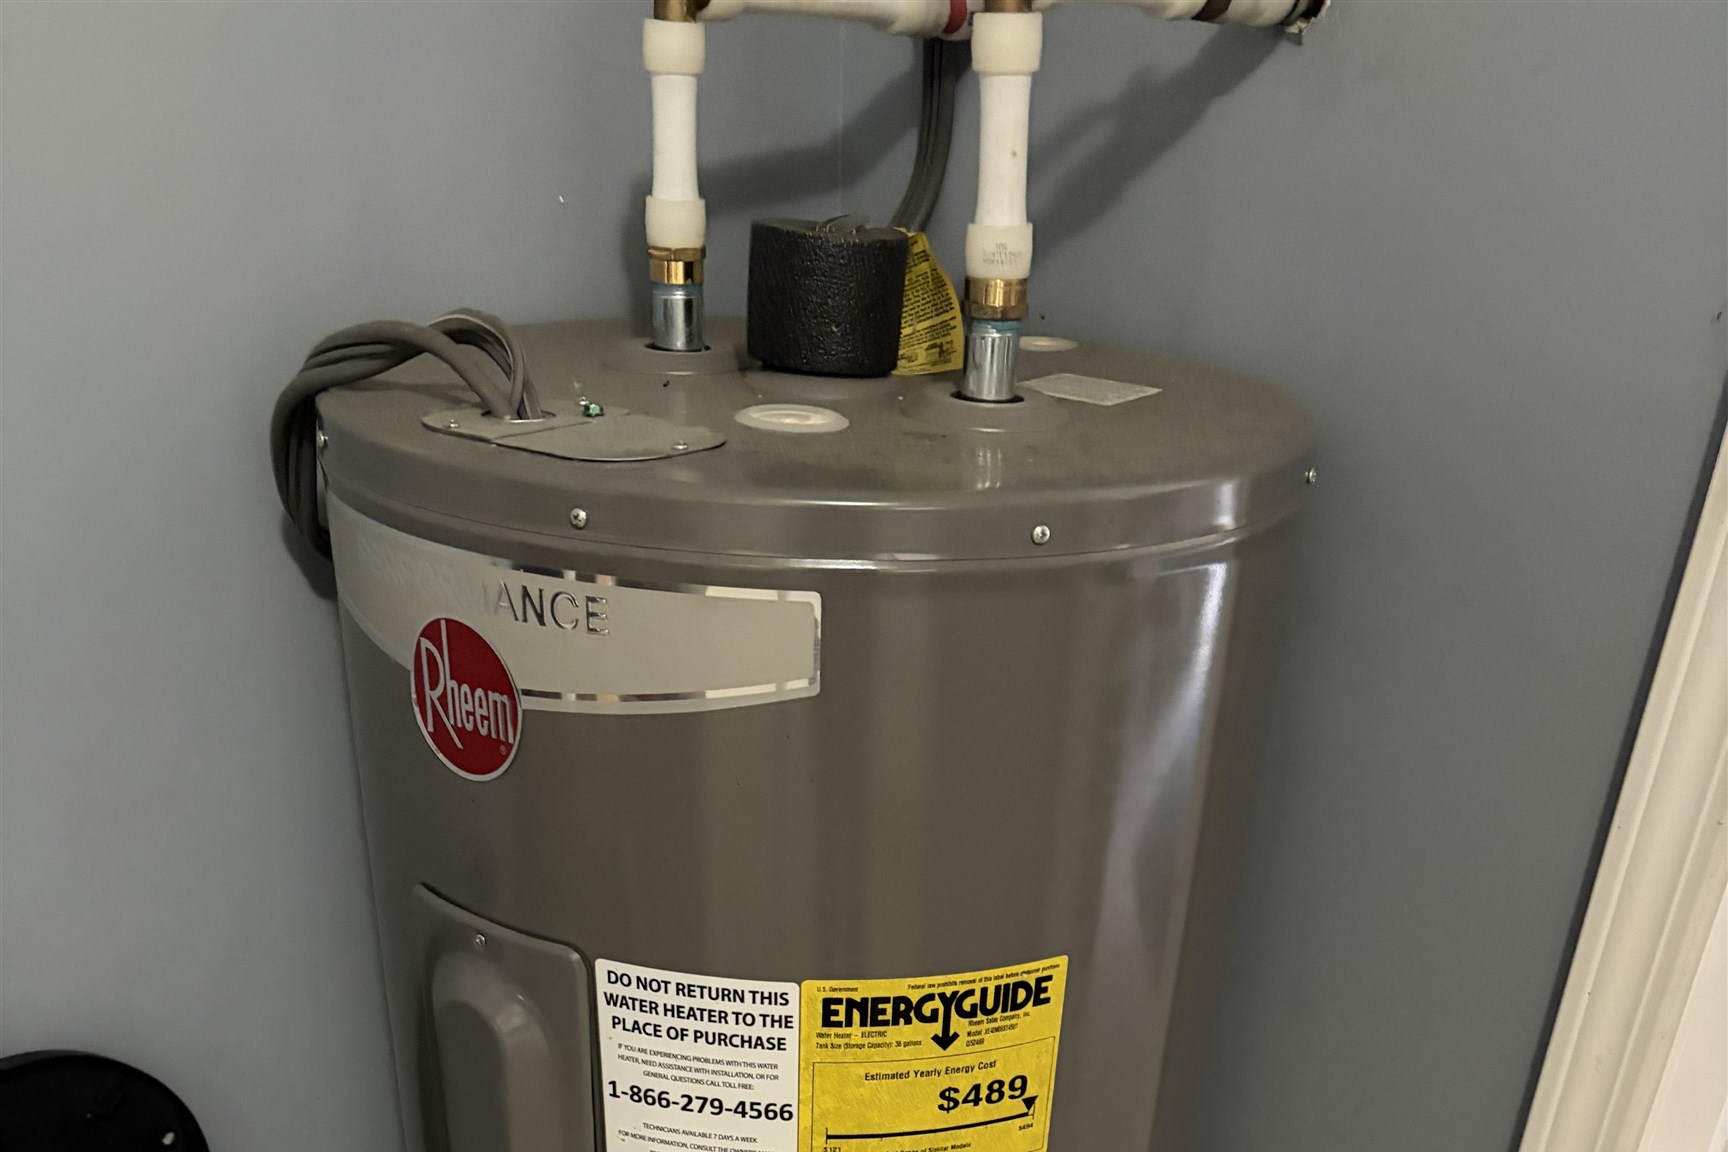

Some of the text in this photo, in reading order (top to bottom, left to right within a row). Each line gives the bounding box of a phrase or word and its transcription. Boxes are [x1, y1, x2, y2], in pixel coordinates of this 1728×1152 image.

[419, 619, 514, 749] Rheem
[607, 970, 789, 1007] DO NOT RETURN THIS
[908, 980, 926, 990] Federal
[937, 978, 958, 988] prohibits
[959, 978, 977, 986] removal
[984, 975, 992, 983] this
[993, 974, 1005, 982] label
[1005, 971, 1019, 980] before
[603, 992, 794, 1030] WATER HEATER TO THE
[821, 975, 1053, 1030] ENERGYGUIDE
[611, 1016, 787, 1051] PLACE OF PURCHASE
[844, 1041, 865, 1050] (Storage
[903, 1040, 922, 1048] gallons
[861, 1030, 888, 1039] ELECTRIC
[617, 1053, 640, 1064] HEATER,
[641, 1059, 657, 1067] NEED
[658, 1062, 693, 1073] ASSISTANCE
[694, 1067, 710, 1075] WITH
[624, 1044, 636, 1052] YOU
[637, 1047, 648, 1055] ARE
[649, 1049, 692, 1061] EXPERIENCING
[692, 1056, 725, 1065] PROBLEMS
[725, 1060, 742, 1068] WITH
[742, 1061, 757, 1069] THIS
[643, 1070, 670, 1081] GENERAL
[670, 1074, 705, 1085] QUESTIONS
[705, 1080, 721, 1088] CALL
[722, 1081, 737, 1089] TOLL
[864, 1060, 997, 1081] Estimated Yearly Energy Cost
[608, 1080, 794, 1122] 1-866-279-4566
[937, 1075, 1028, 1114] $489
[618, 1129, 629, 1137] FOR
[630, 1132, 646, 1140] MORE
[647, 1136, 689, 1149] INFORMATION,
[689, 1143, 717, 1152] CONSULT
[643, 1122, 681, 1135] TECHNICIANS
[681, 1129, 712, 1139] AVAILABLE
[718, 1134, 734, 1142] DAYS
[740, 1136, 758, 1144] WEEK
[951, 1142, 972, 1151] Models
